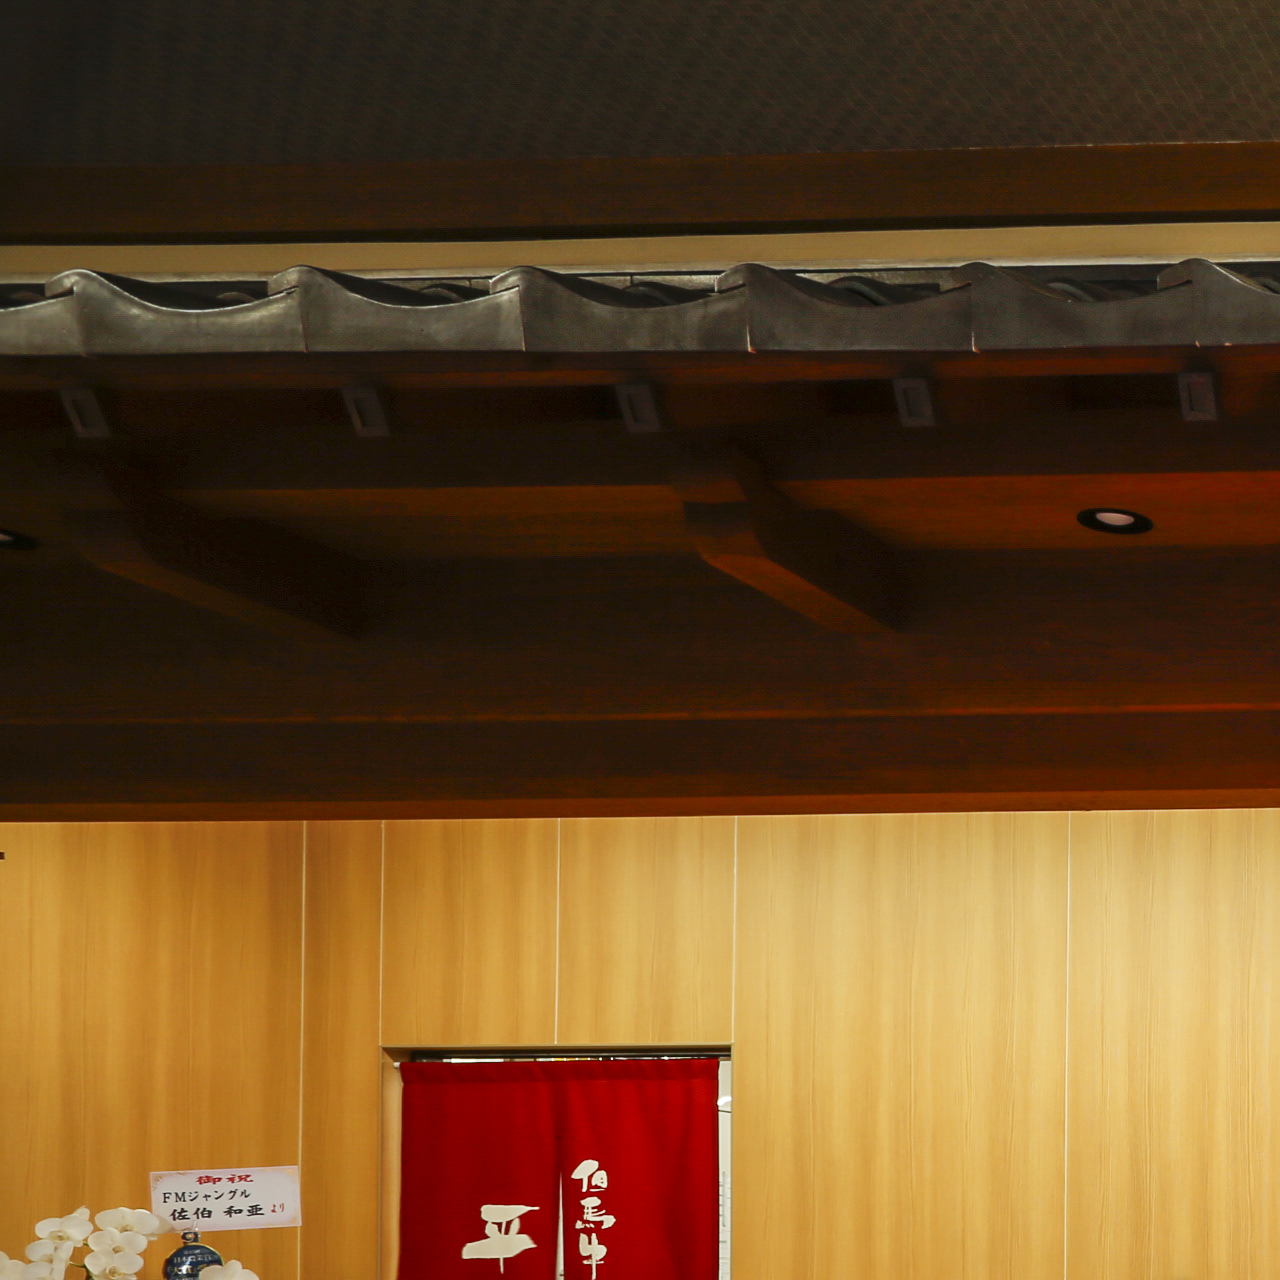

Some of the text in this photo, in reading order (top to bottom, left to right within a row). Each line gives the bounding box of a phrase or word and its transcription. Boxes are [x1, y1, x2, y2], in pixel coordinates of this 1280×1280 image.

[195, 1174, 254, 1185] 御祝
[162, 1189, 251, 1204] FMジャングル
[170, 1203, 285, 1221] 佐伯 和亜 より
[571, 1159, 616, 1280] 但馬牛
